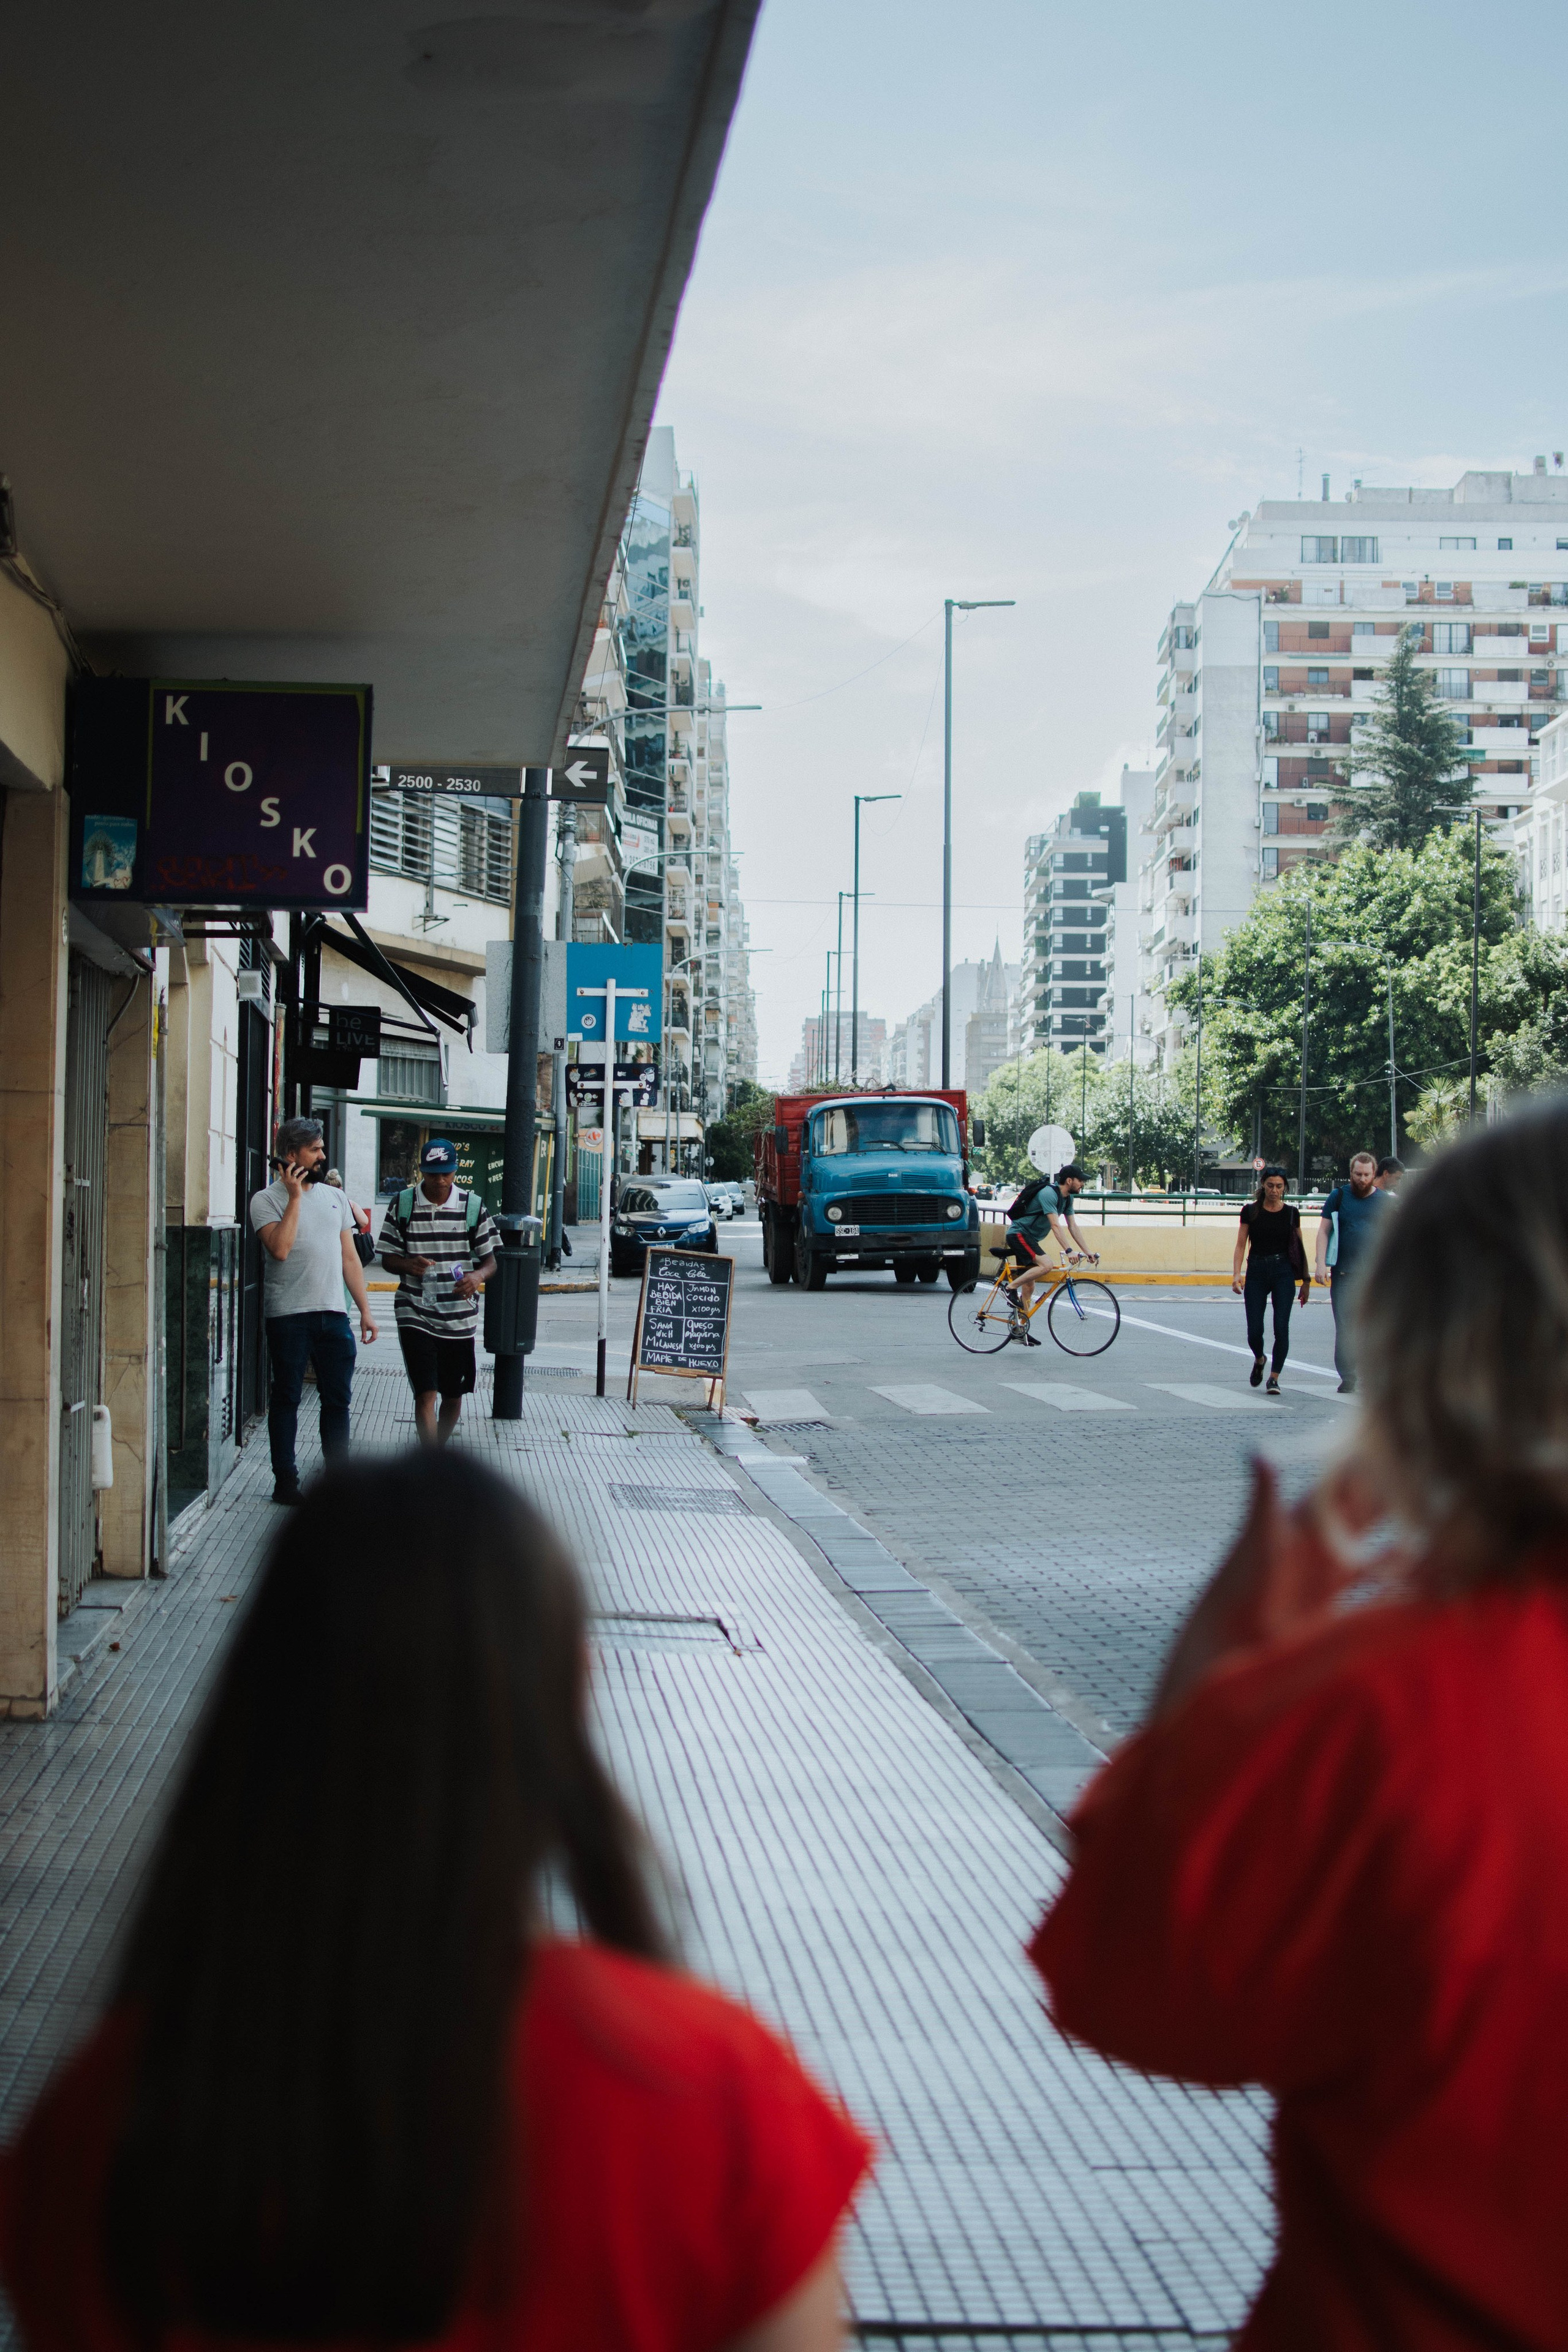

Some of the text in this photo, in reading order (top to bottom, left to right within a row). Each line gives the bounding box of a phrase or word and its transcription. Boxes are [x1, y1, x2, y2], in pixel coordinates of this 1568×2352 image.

[398, 775, 433, 789] 2500
[446, 777, 481, 792] 2530
[165, 695, 352, 894] KIOSKO
[336, 1011, 361, 1029] be
[336, 1031, 375, 1045] LIVE
[429, 1147, 445, 1156] NIKE
[459, 1159, 475, 1168] RAY
[658, 1267, 680, 1278] Coca
[658, 1282, 677, 1292] HAY
[650, 1290, 682, 1300] BEBIDA
[688, 1357, 719, 1367] HUEVO
